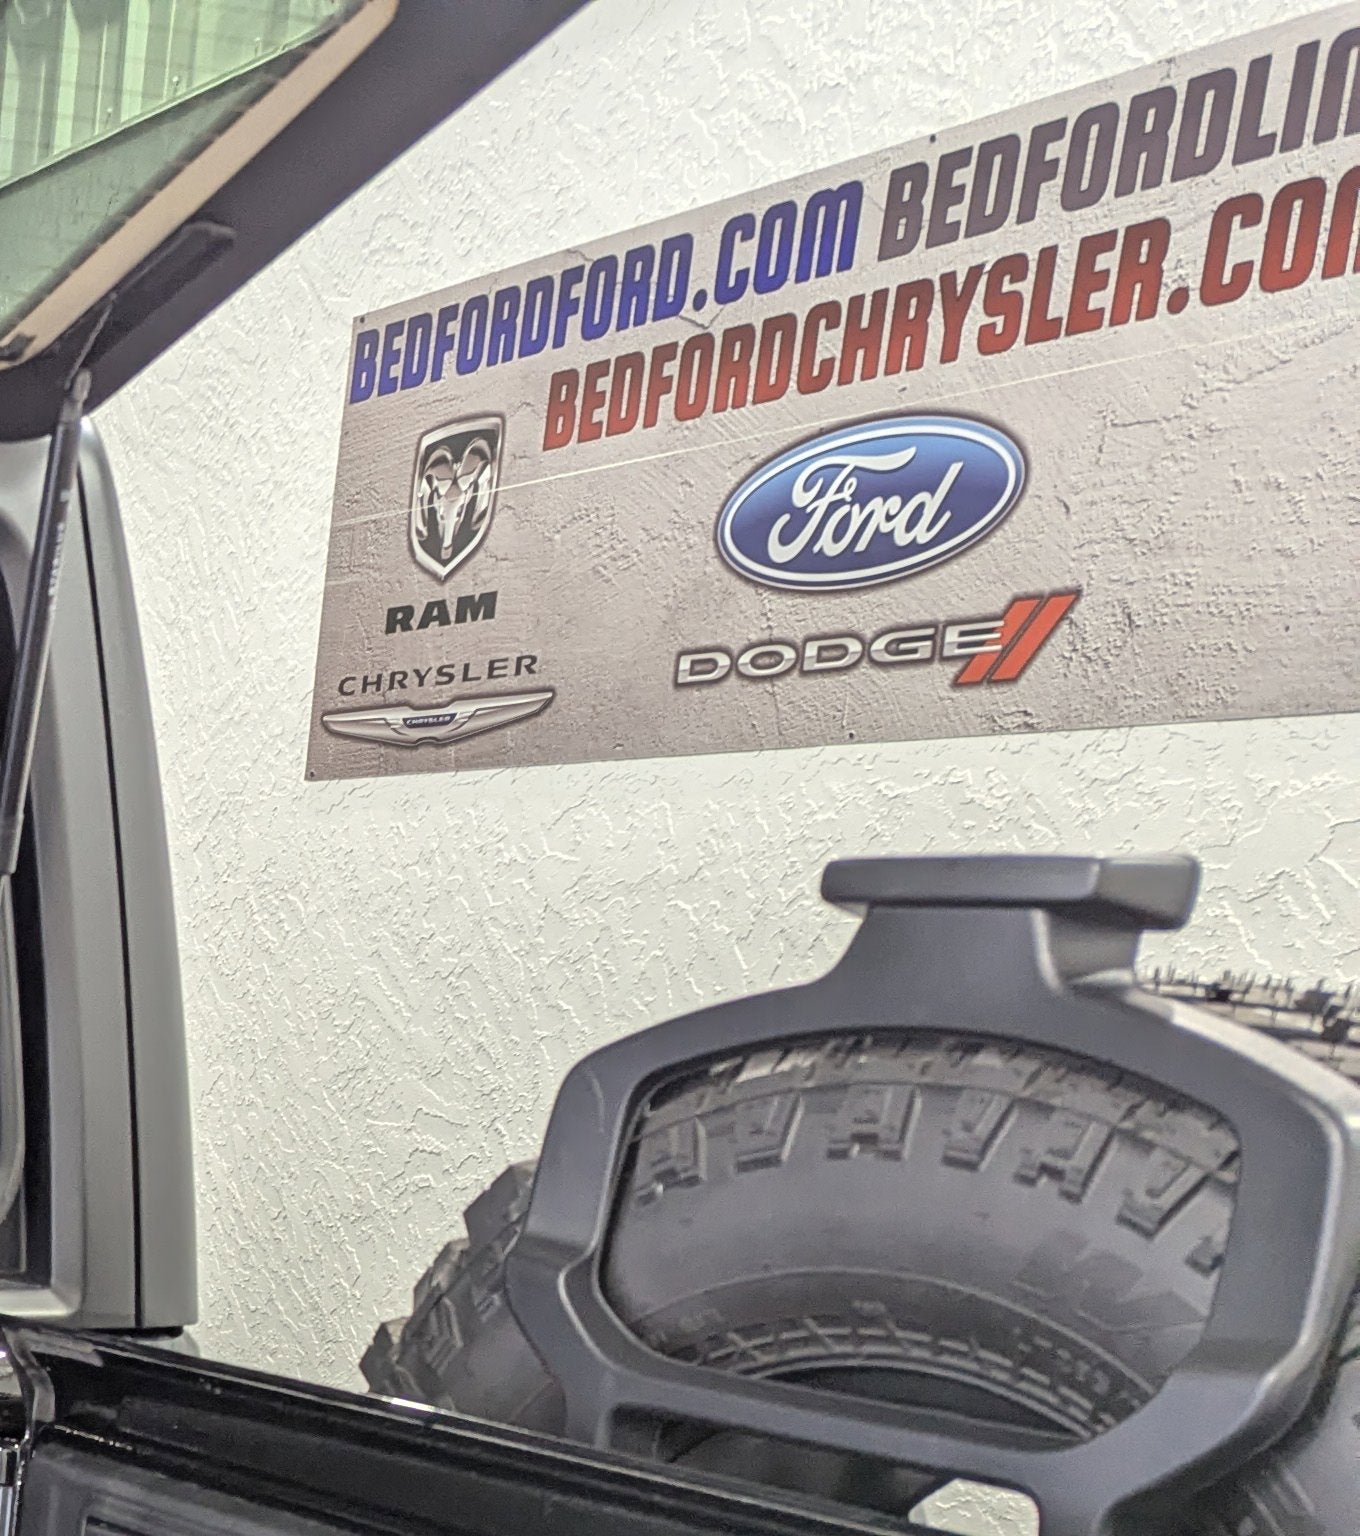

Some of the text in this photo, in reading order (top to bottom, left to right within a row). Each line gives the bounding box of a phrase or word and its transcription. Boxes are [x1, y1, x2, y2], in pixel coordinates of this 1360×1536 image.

[349, 180, 864, 404] BEDFORDFORD.COM
[767, 446, 965, 564] Ford
[385, 590, 498, 635] RAM
[337, 654, 538, 697] CHRYSLER
[676, 619, 1006, 685] DODGE
